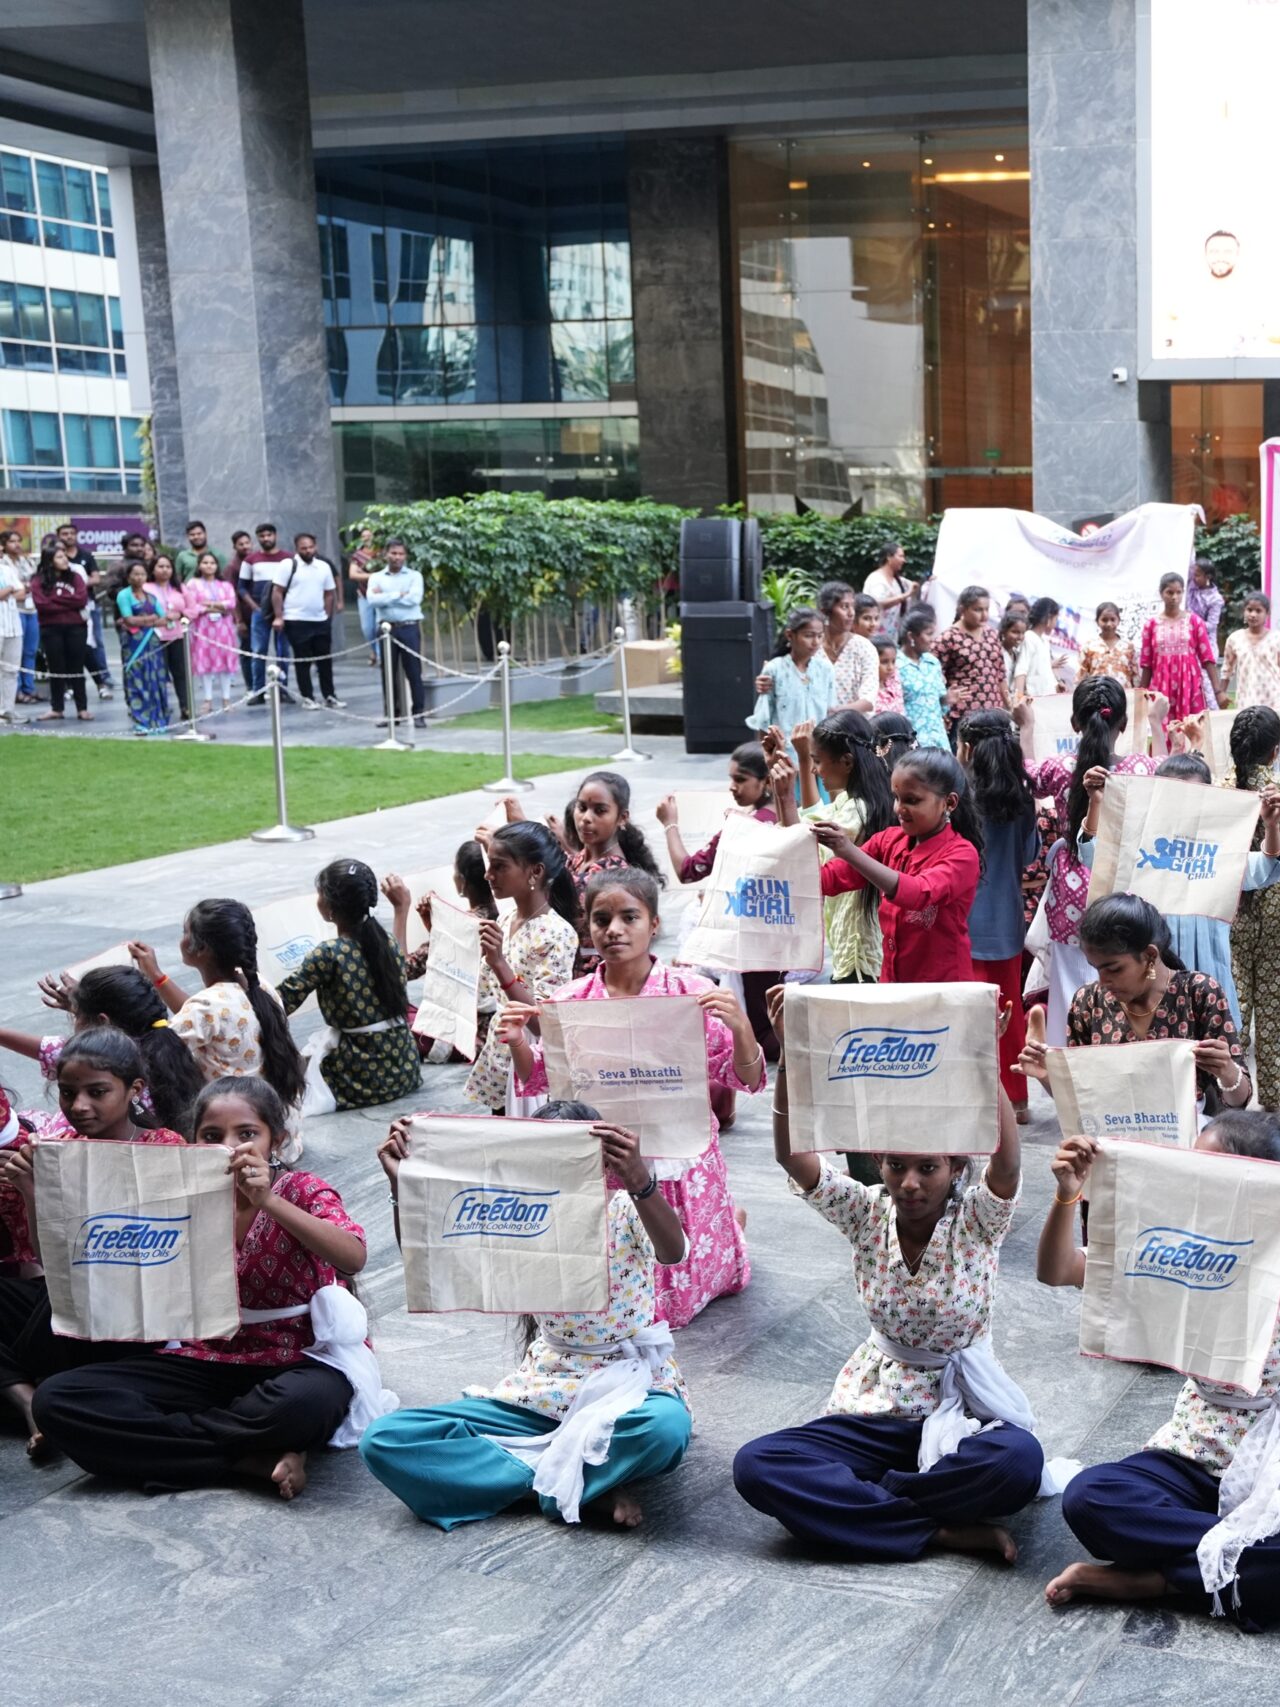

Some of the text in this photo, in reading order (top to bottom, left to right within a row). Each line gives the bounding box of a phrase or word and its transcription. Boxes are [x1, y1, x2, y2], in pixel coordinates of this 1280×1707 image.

[1169, 838, 1219, 858] RUN
[1169, 857, 1214, 874] GIRL
[744, 878, 790, 898] RUN
[742, 896, 790, 917] GIRL
[764, 914, 796, 925] CHILD
[840, 1036, 937, 1064] Freedom
[598, 1066, 682, 1080] Seva Bharathi
[837, 1061, 928, 1073] Healthy Cooking Oils
[1104, 1114, 1132, 1126] Seva
[456, 1197, 549, 1222] Freedom
[84, 1224, 179, 1249] Freedom
[452, 1221, 541, 1232] Healthy Cooking Oils
[81, 1248, 170, 1260] Healthy Cooking Oils
[1138, 1236, 1238, 1274] Freedom
[1134, 1262, 1226, 1283] Healthy Cooking Oils
